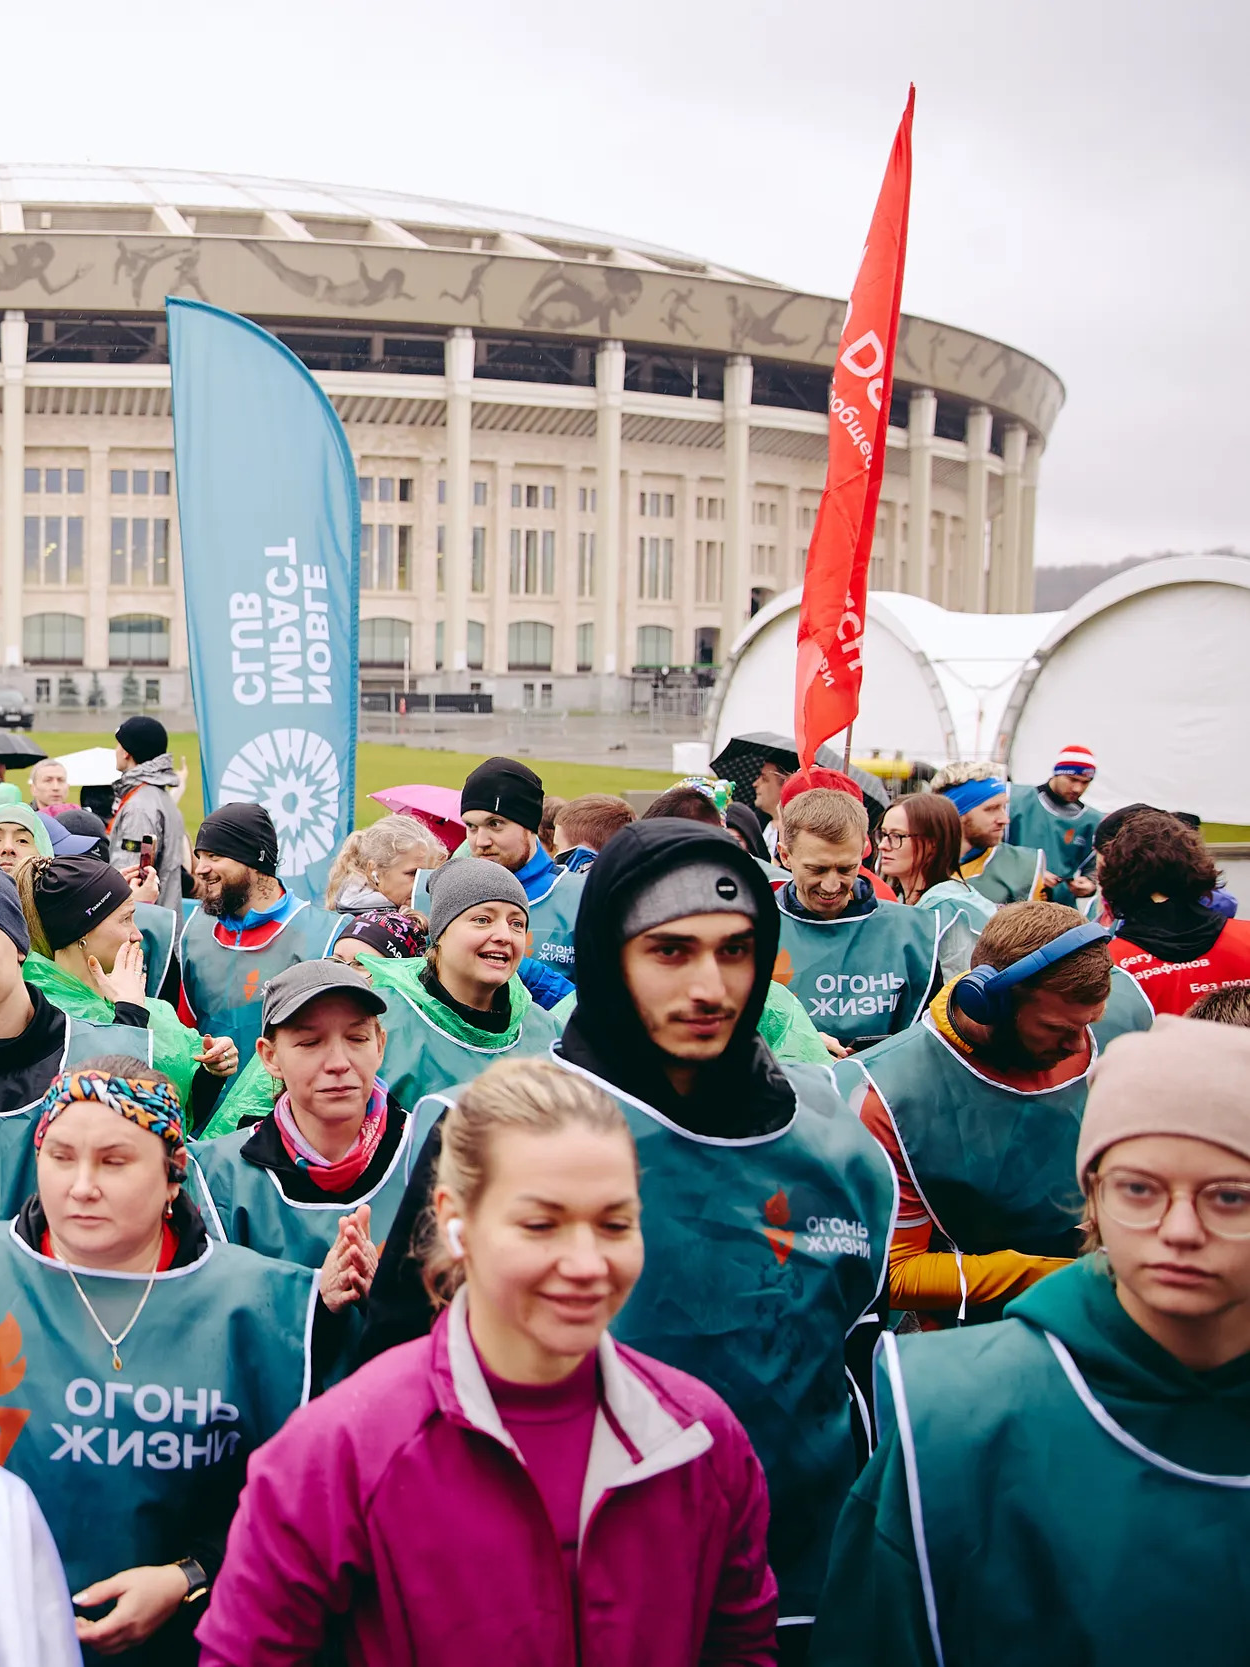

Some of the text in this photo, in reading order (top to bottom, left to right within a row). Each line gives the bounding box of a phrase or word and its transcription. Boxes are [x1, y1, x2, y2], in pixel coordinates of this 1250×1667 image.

[1132, 958, 1210, 980] арафонов
[815, 971, 905, 994] ОГОНЬ
[1189, 982, 1217, 994] Без
[806, 1216, 869, 1239] ОГОНЬ
[803, 1235, 871, 1260] ЖИЗНИ
[65, 1377, 240, 1426] ОГОНЬ
[49, 1422, 242, 1470] ЖИЗНИ
